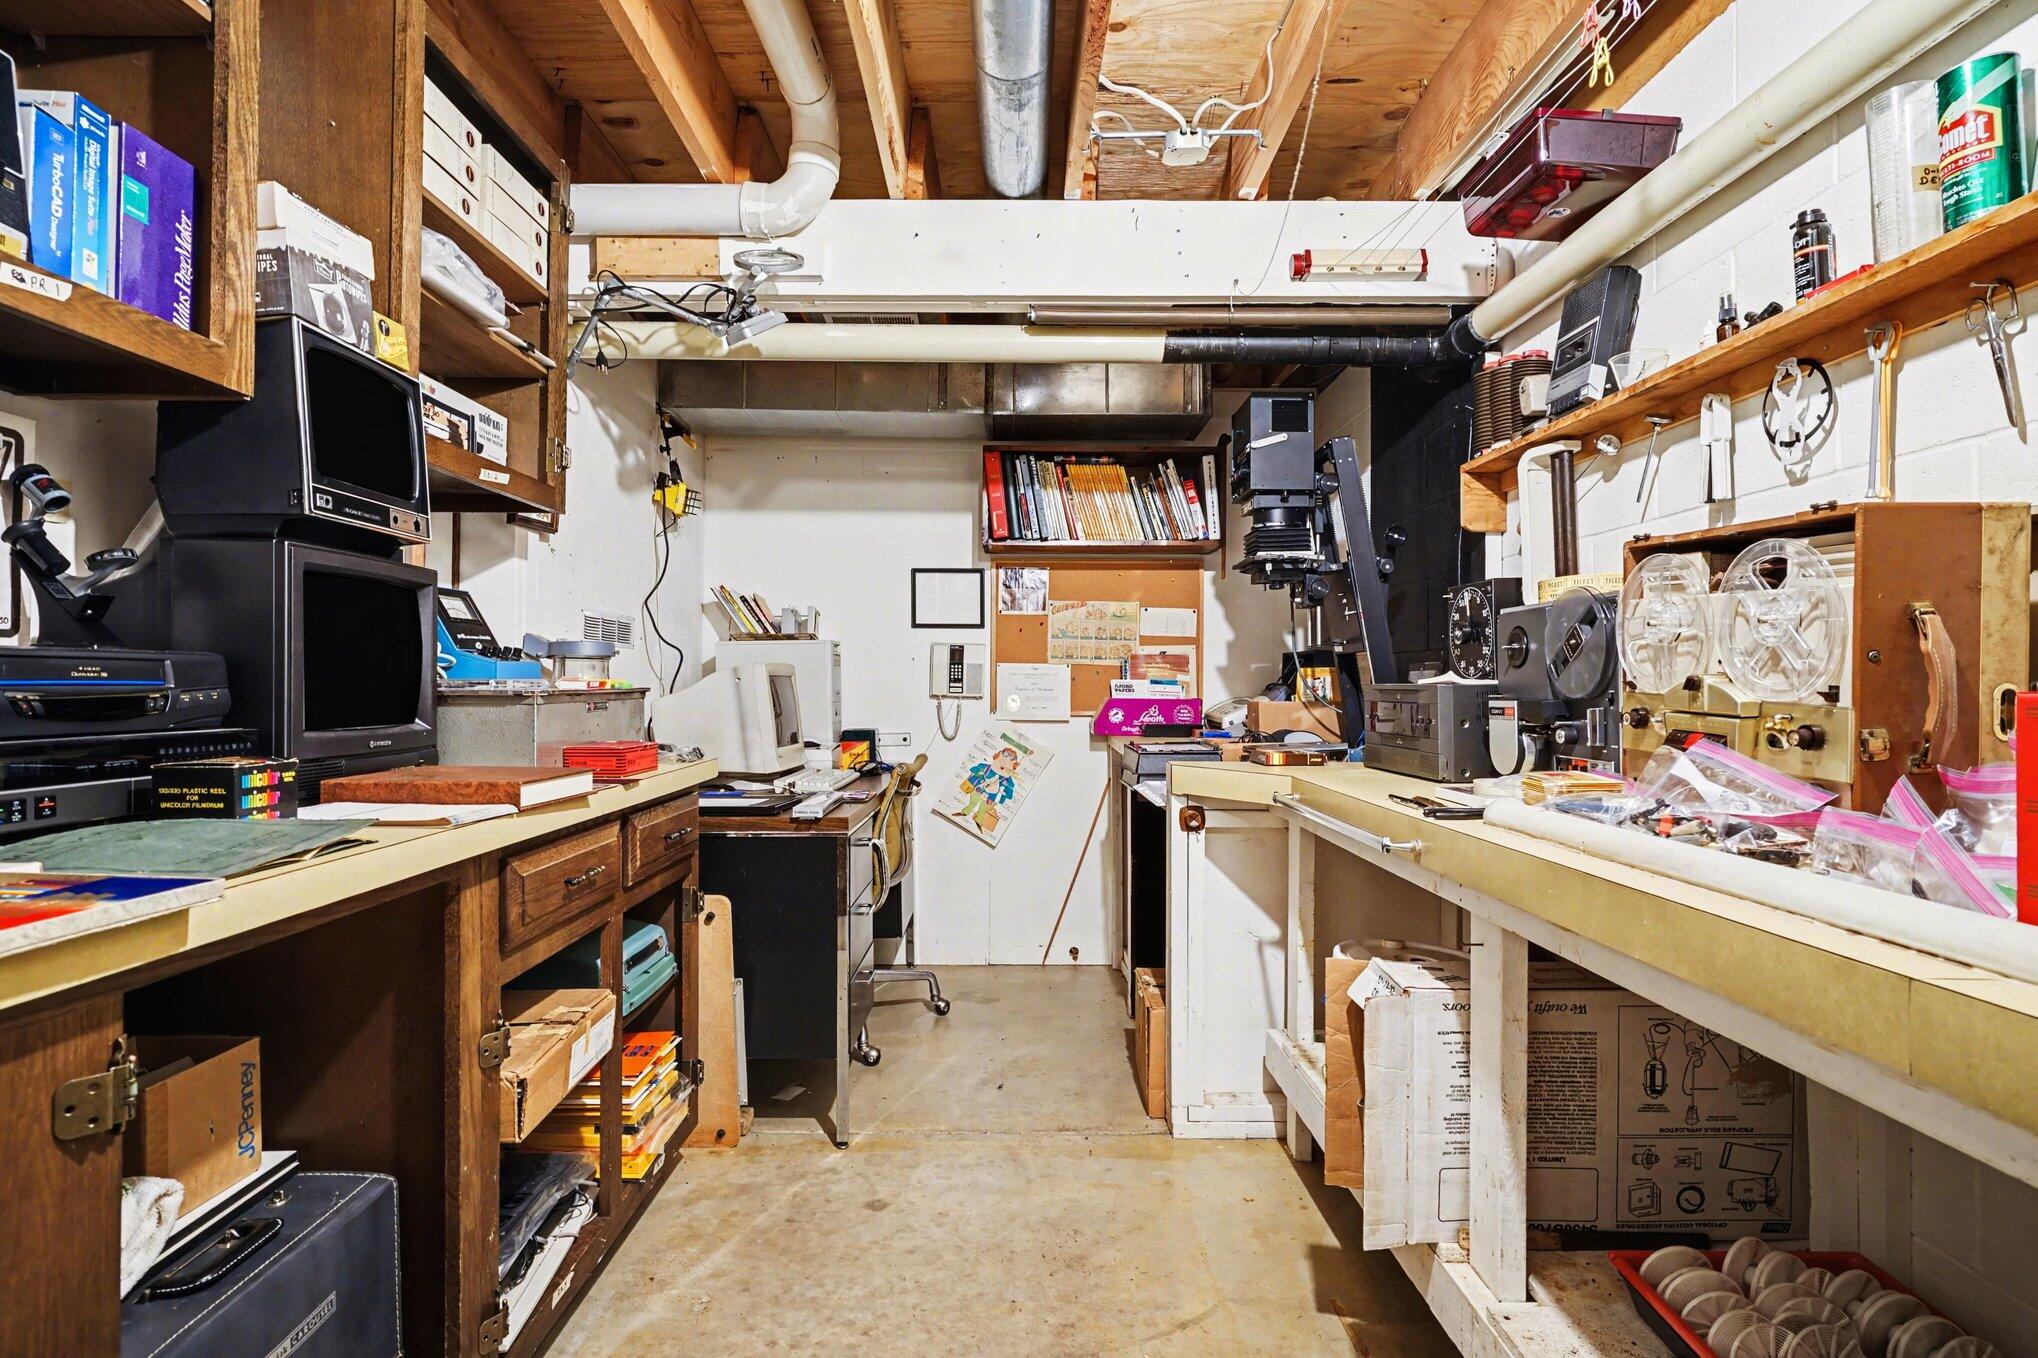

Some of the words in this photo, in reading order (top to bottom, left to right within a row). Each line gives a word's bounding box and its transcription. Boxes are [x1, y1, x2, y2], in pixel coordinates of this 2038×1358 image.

[50, 151, 65, 219] TurboCAD
[241, 768, 281, 789] unicolor
[241, 788, 281, 809] unicolor
[1534, 1001, 1568, 1015] outfit
[1570, 1003, 1588, 1015] We
[237, 1061, 257, 1159] JCPenney
[289, 1299, 335, 1348] CAROUSEL
